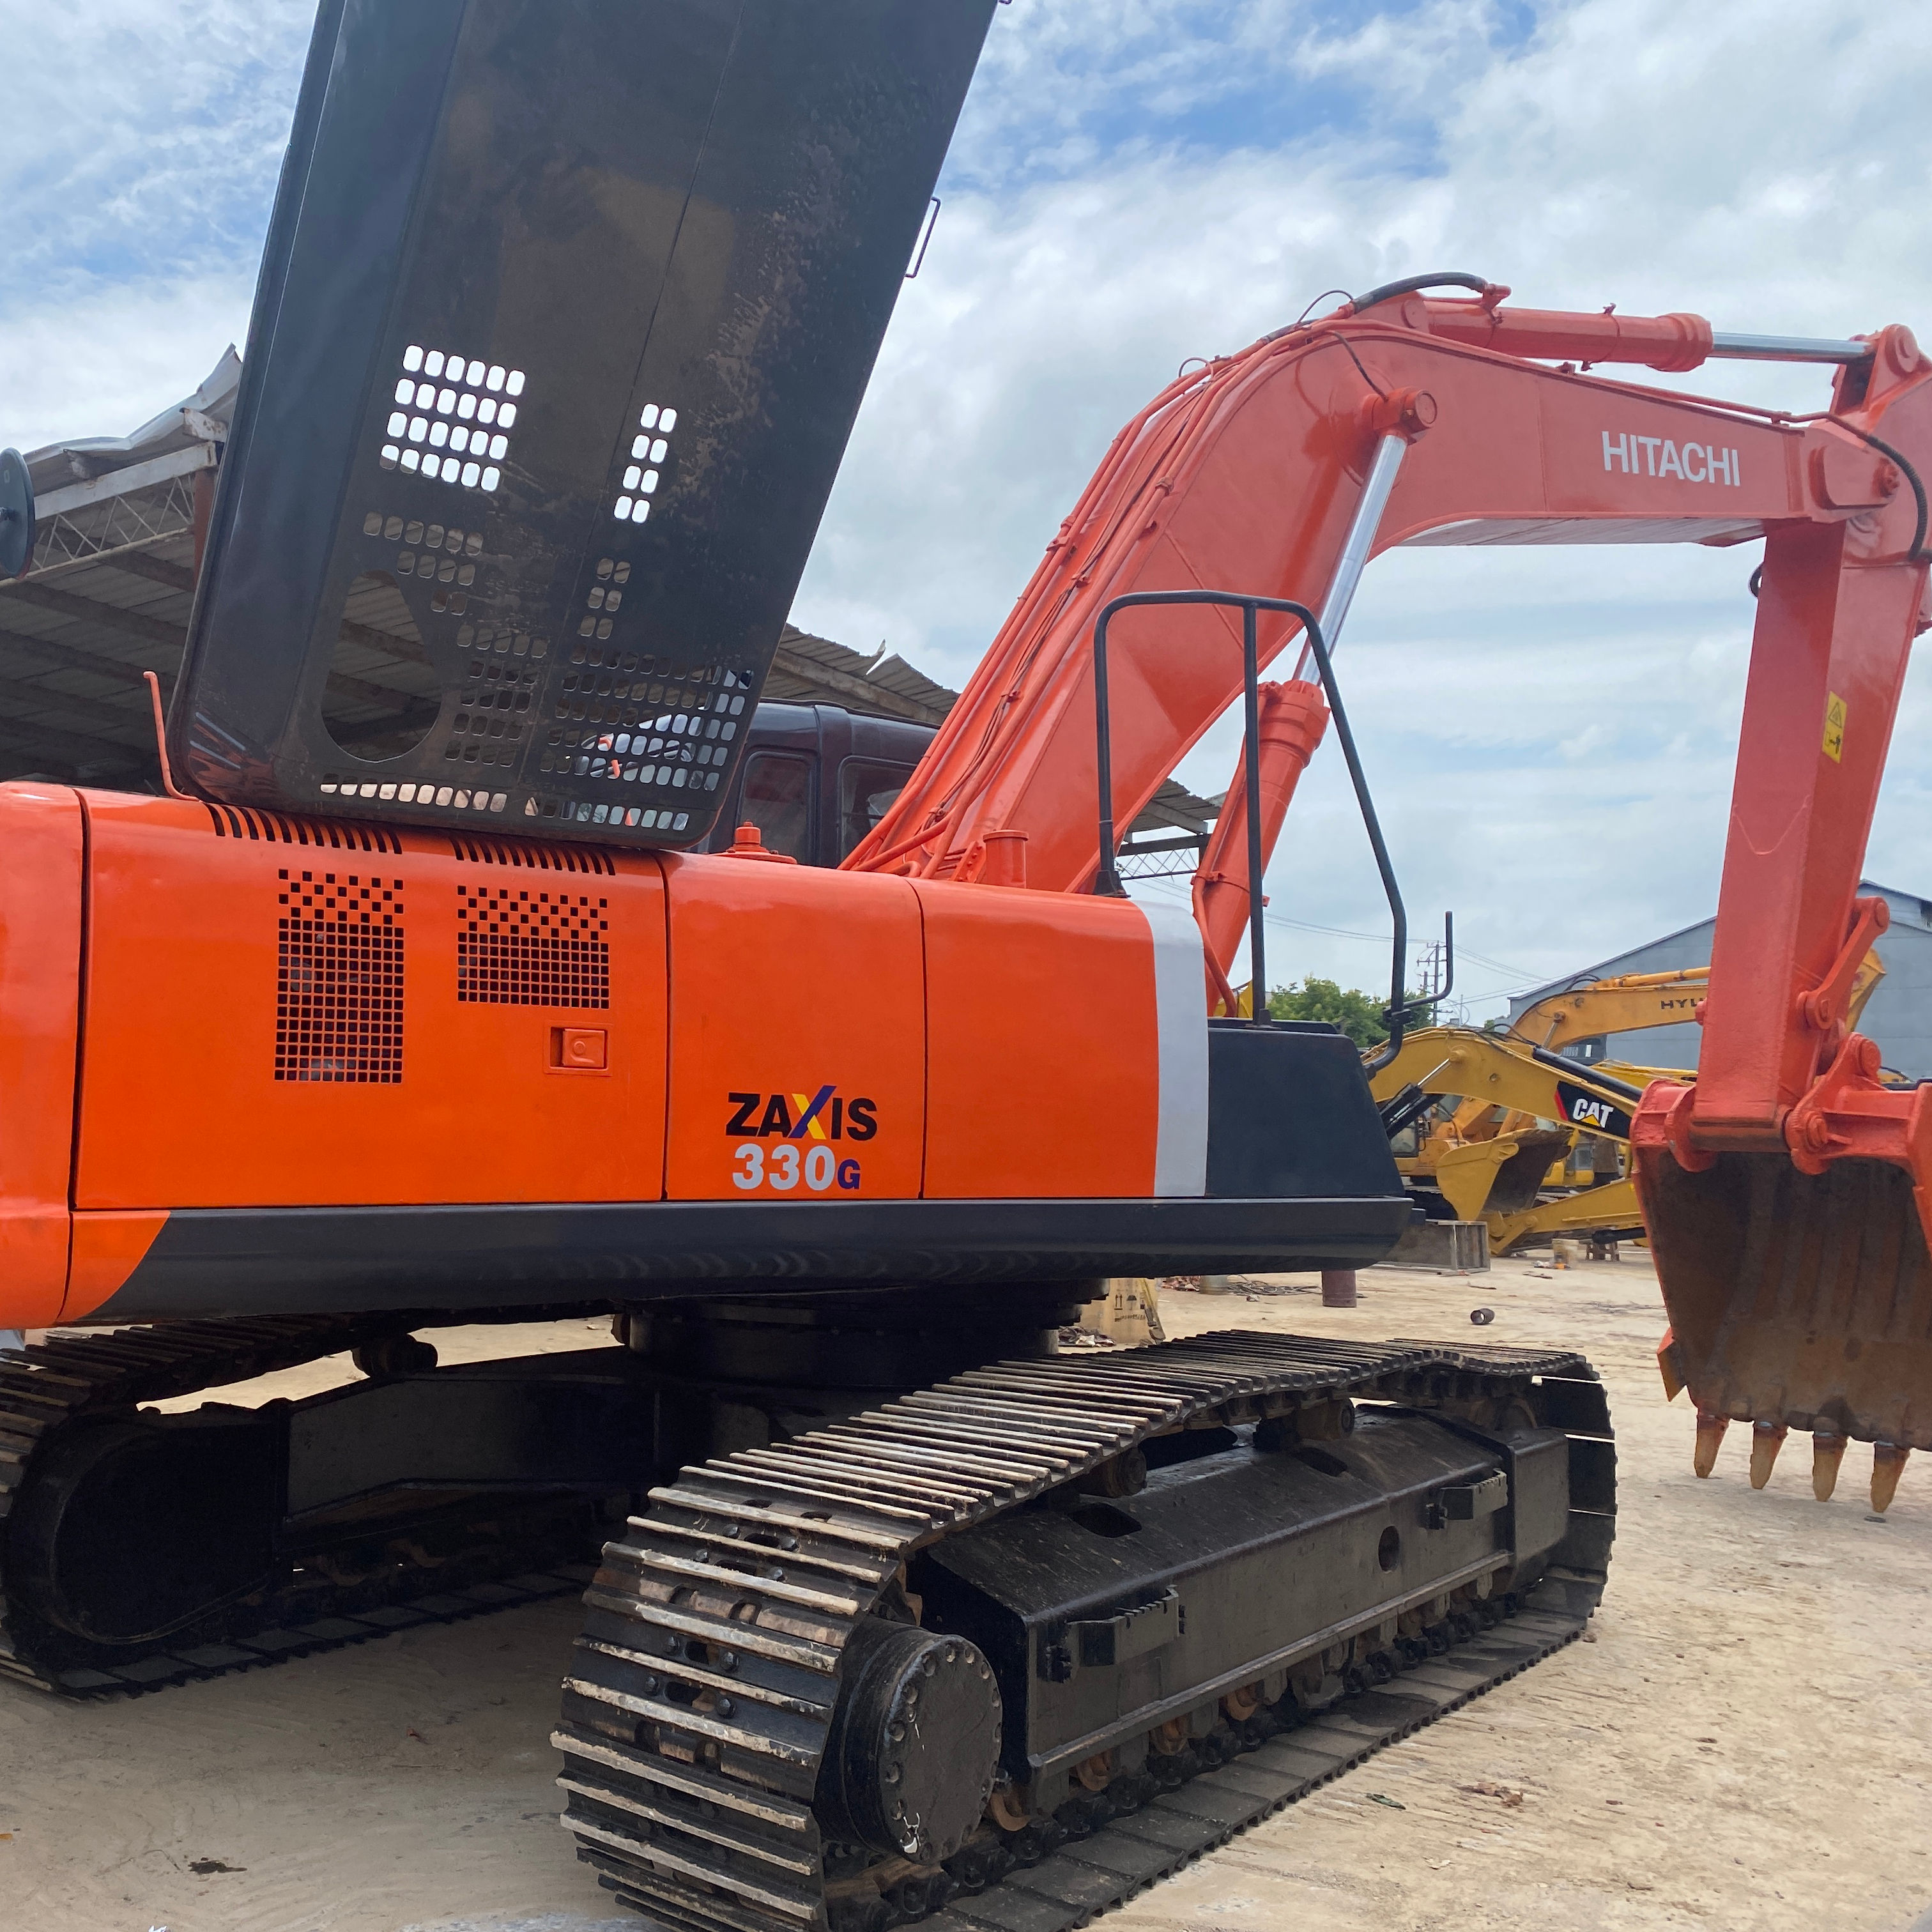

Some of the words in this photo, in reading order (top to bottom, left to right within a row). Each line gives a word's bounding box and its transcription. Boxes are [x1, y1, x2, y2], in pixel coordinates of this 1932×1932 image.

[1602, 431, 1740, 486] HITACHI
[726, 1085, 877, 1141] ZAXIS
[1572, 1098, 1614, 1128] CAT
